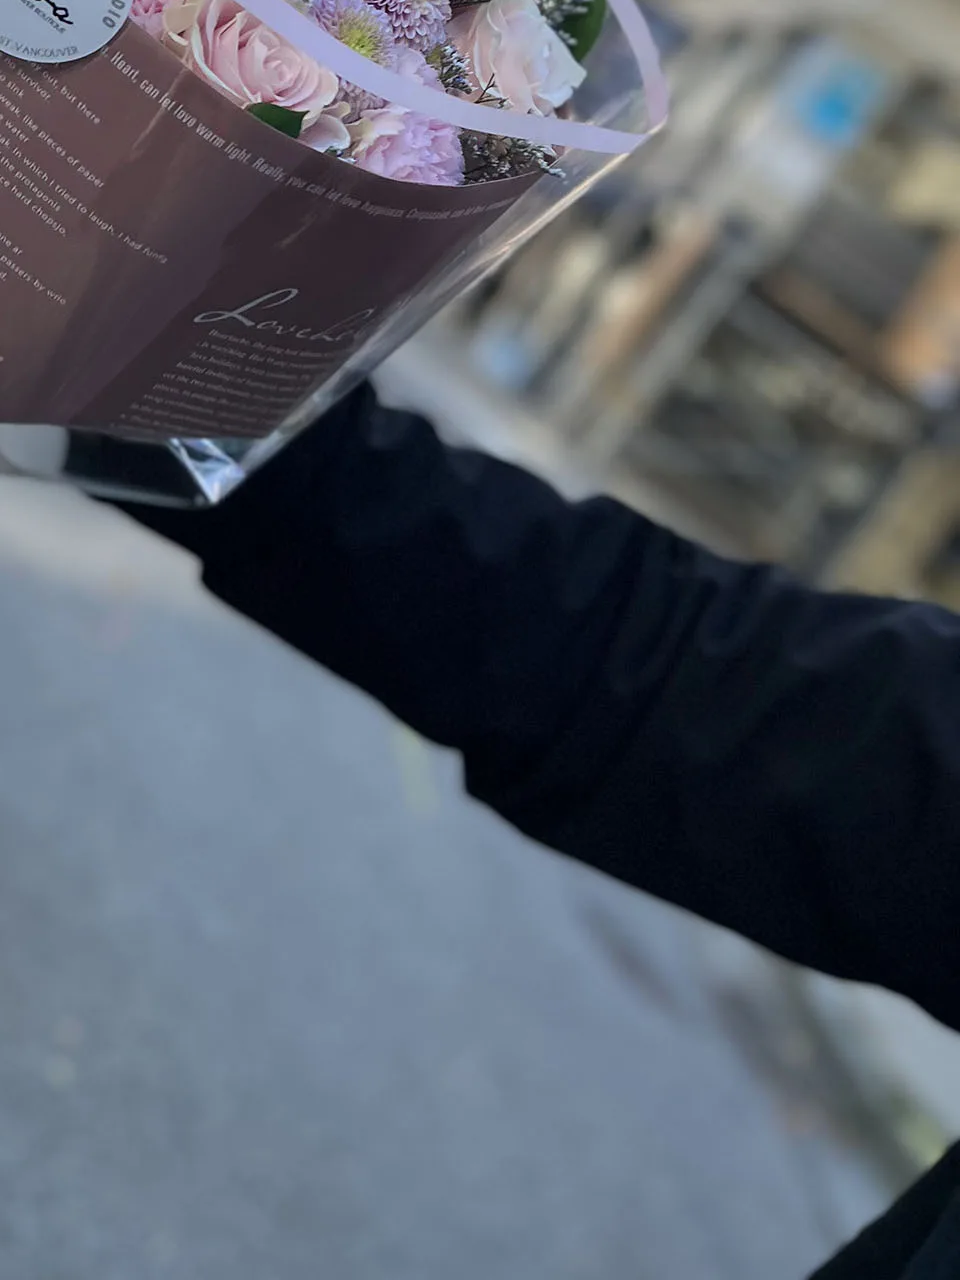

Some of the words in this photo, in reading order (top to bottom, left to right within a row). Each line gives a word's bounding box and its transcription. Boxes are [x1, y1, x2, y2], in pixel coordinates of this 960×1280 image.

[6, 81, 24, 98] sink
[60, 86, 82, 108] but
[80, 104, 101, 124] there
[110, 51, 139, 83] Heart,
[139, 79, 160, 99] can
[158, 92, 176, 111] let
[173, 104, 197, 128] love
[196, 123, 225, 148] warm
[5, 120, 29, 143] water
[22, 114, 38, 132] like
[37, 130, 66, 157] pieces
[66, 156, 80, 166] of
[77, 165, 104, 188] paper
[11, 185, 32, 205] hard
[23, 156, 49, 182] which
[54, 184, 77, 205] tried
[76, 202, 88, 214] to
[123, 235, 143, 250] had
[12, 246, 23, 255] ar
[0, 255, 31, 282] passers
[33, 279, 45, 291] by
